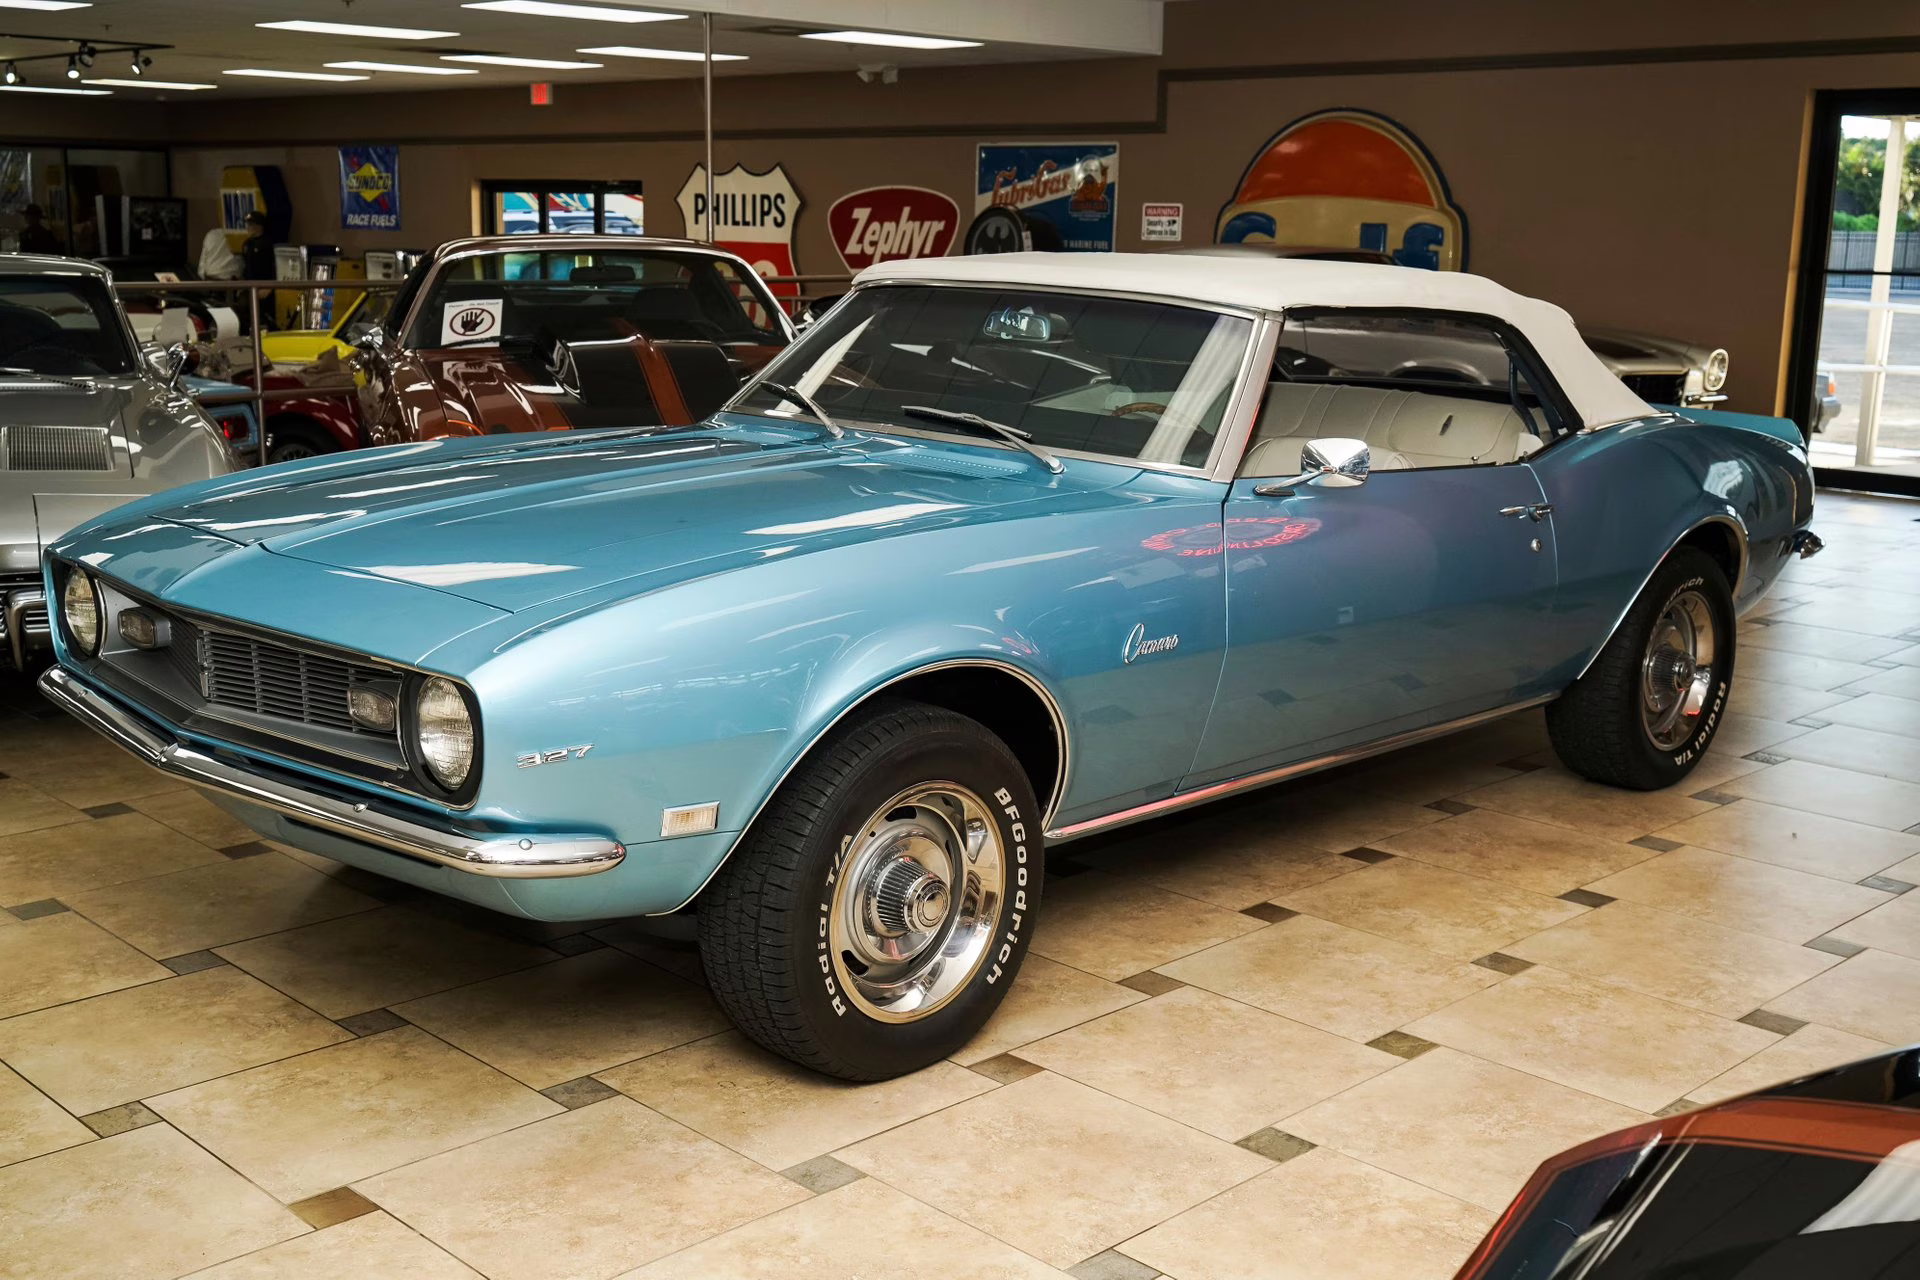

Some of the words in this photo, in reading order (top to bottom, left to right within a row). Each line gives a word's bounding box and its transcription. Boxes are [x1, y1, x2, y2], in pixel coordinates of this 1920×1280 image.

[348, 174, 391, 190] SUNOCO
[346, 213, 370, 226] RACE
[370, 213, 396, 227] FUELS
[694, 193, 785, 228] PHILLIPS
[1146, 207, 1179, 216] WARNING
[845, 206, 946, 260] Zephyr
[1068, 240, 1092, 249] MARINE
[1094, 240, 1109, 250] FUEL
[1122, 623, 1179, 664] Camaro
[1694, 681, 1727, 752] Radial
[516, 743, 594, 769] 327
[1673, 747, 1694, 767] T/A
[825, 834, 853, 886] T/A
[986, 787, 1027, 985] BFGoodrich
[817, 903, 847, 1017] Radial
